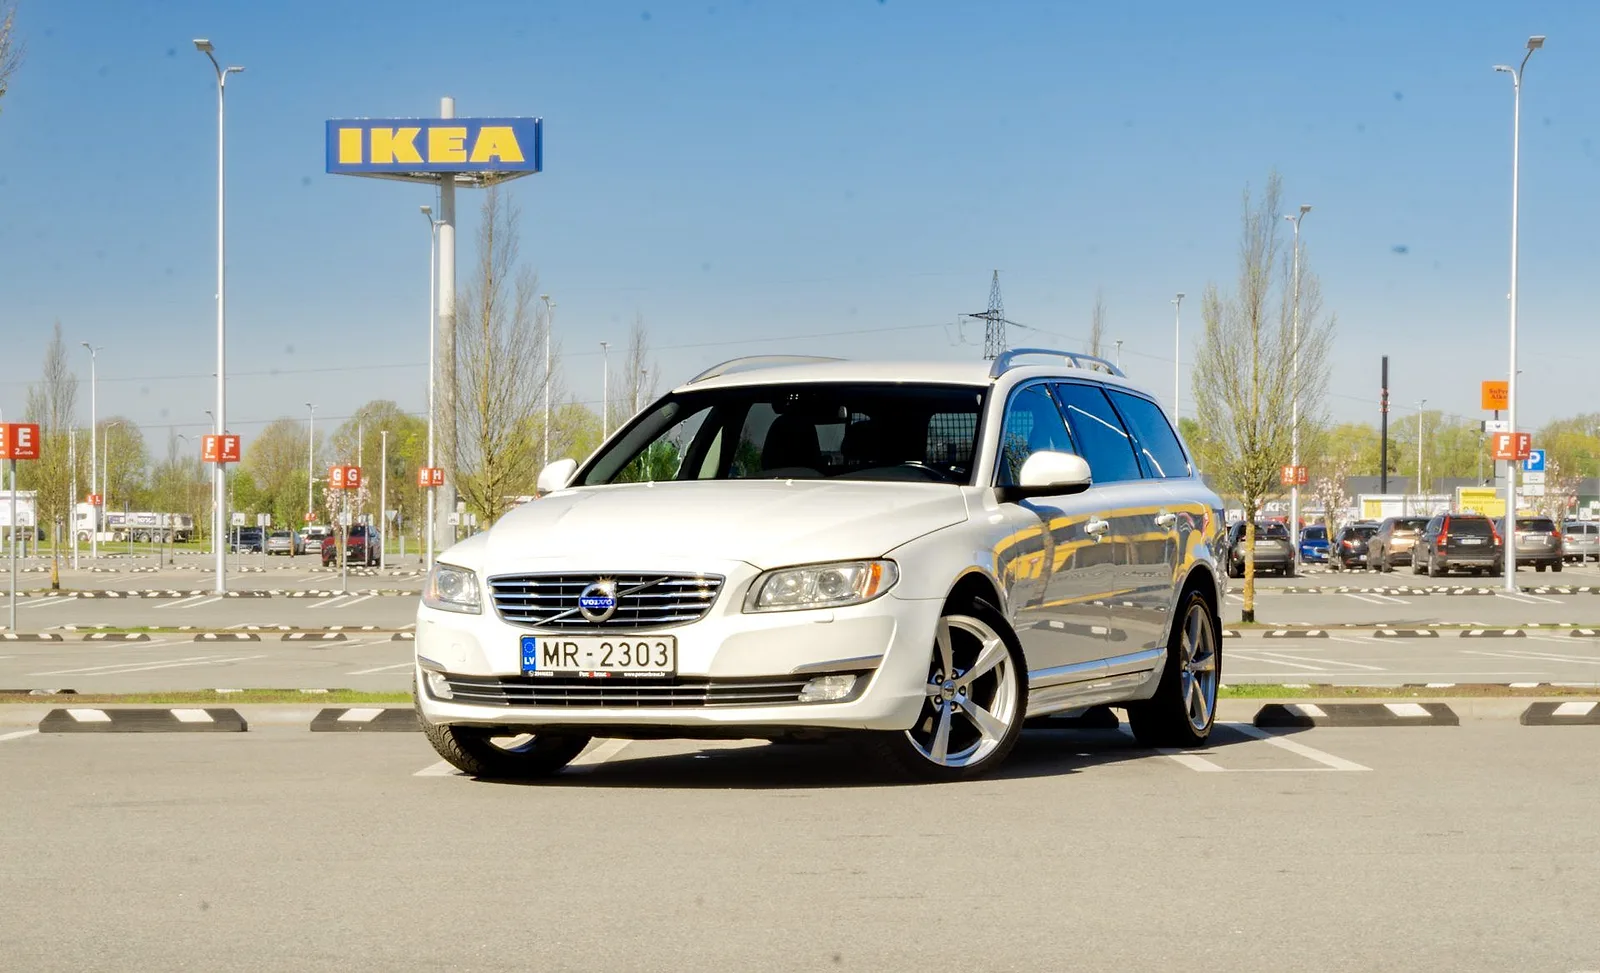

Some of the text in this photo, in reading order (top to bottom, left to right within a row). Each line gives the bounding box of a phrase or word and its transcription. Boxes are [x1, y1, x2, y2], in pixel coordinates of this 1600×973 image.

[338, 126, 525, 164] IKEA
[18, 427, 31, 447] E
[1500, 435, 1510, 451] F
[1520, 436, 1527, 450] F
[207, 437, 214, 453] F
[224, 437, 234, 453] F
[1527, 452, 1541, 469] P
[333, 468, 341, 481] G
[348, 468, 358, 482] G
[421, 469, 427, 480] H
[433, 469, 442, 480] H
[1265, 502, 1290, 511] KFC
[523, 656, 535, 665] LV
[542, 641, 668, 667] MR-2303
